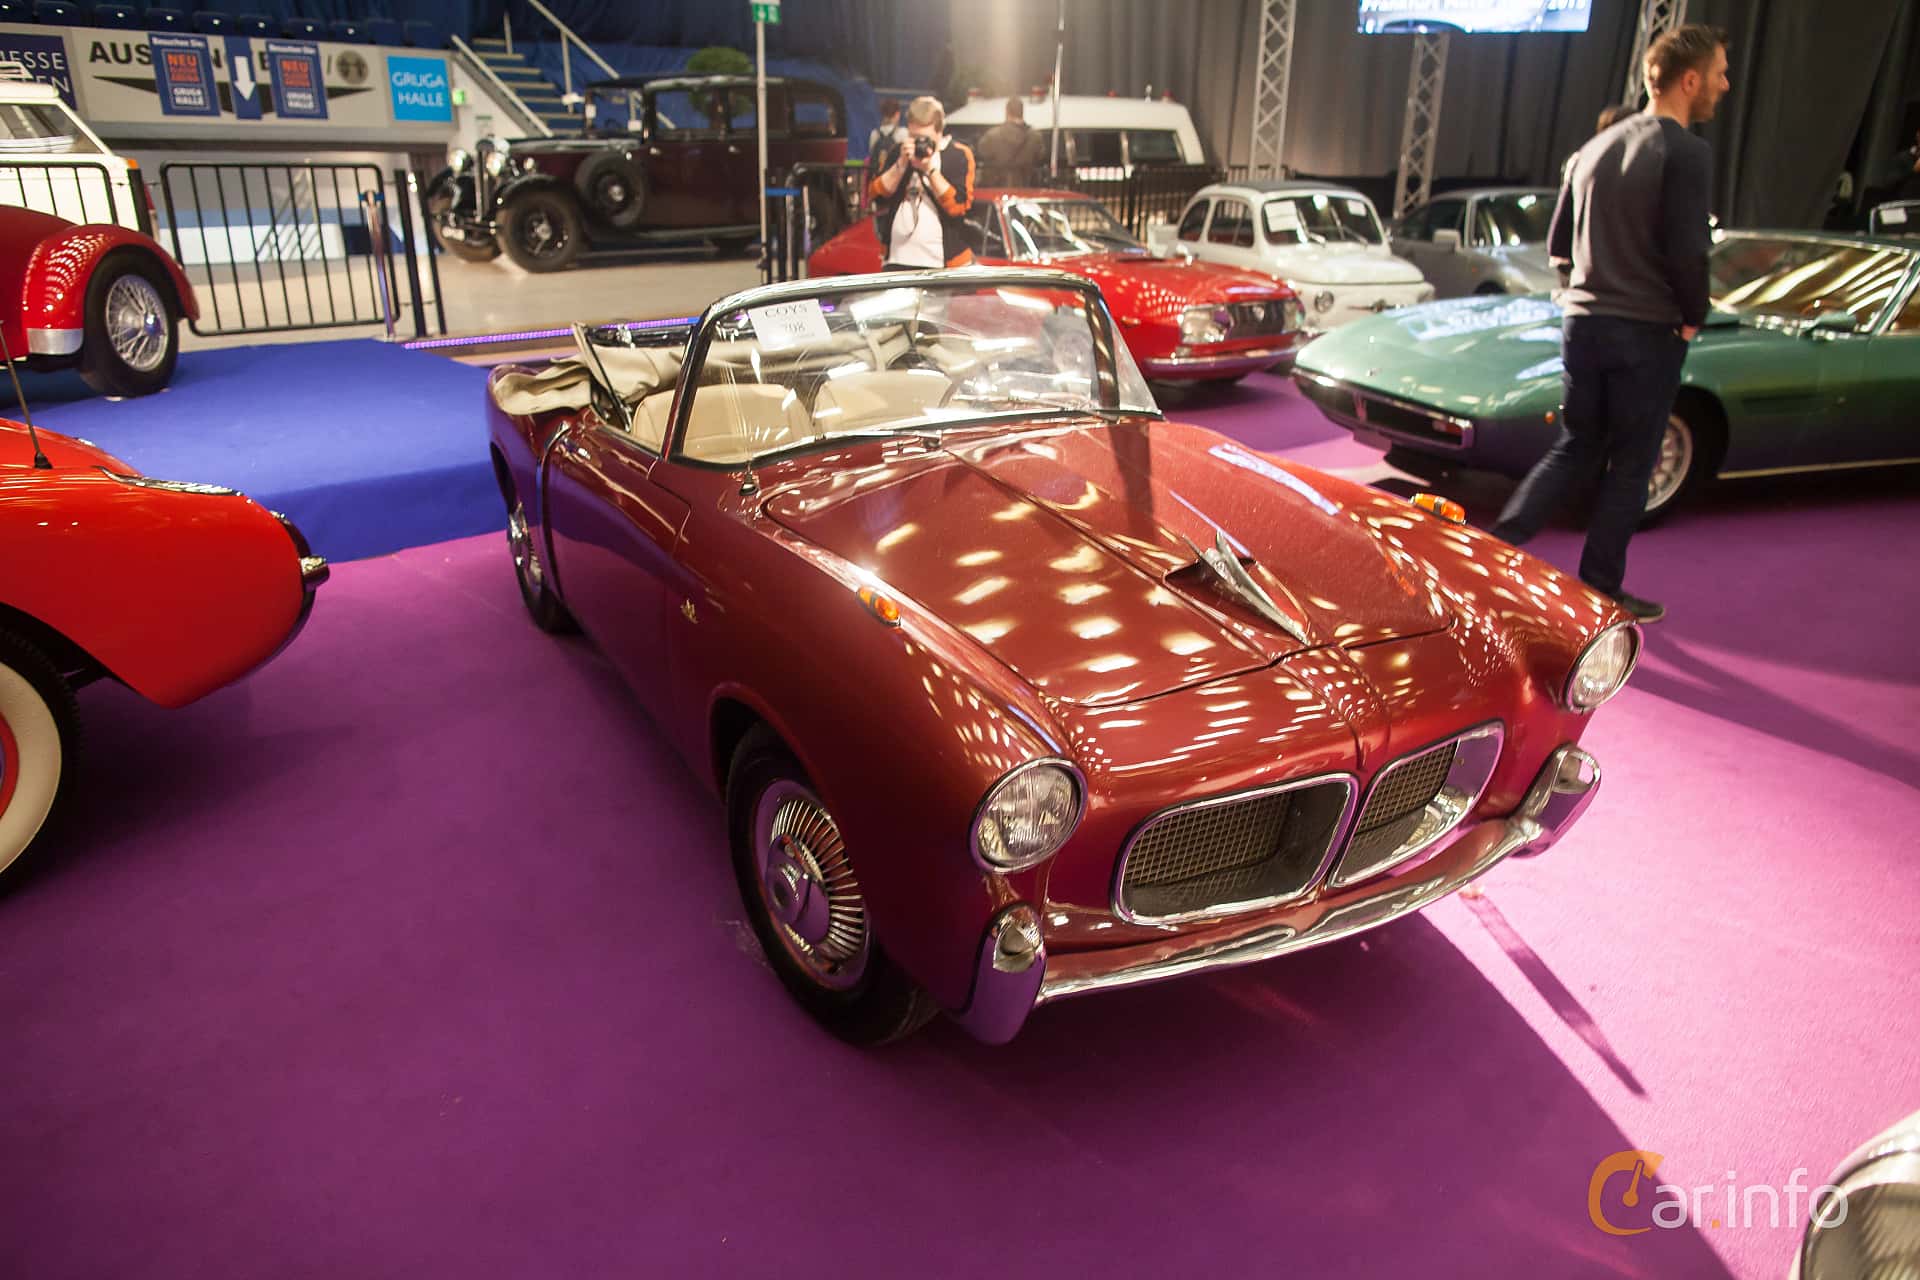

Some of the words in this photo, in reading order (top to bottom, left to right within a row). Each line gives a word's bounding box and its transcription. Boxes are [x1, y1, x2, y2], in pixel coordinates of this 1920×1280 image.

[167, 53, 197, 66] NEU
[391, 71, 445, 89] GRUGA
[397, 91, 444, 108] HALLE
[764, 303, 808, 318] COYS
